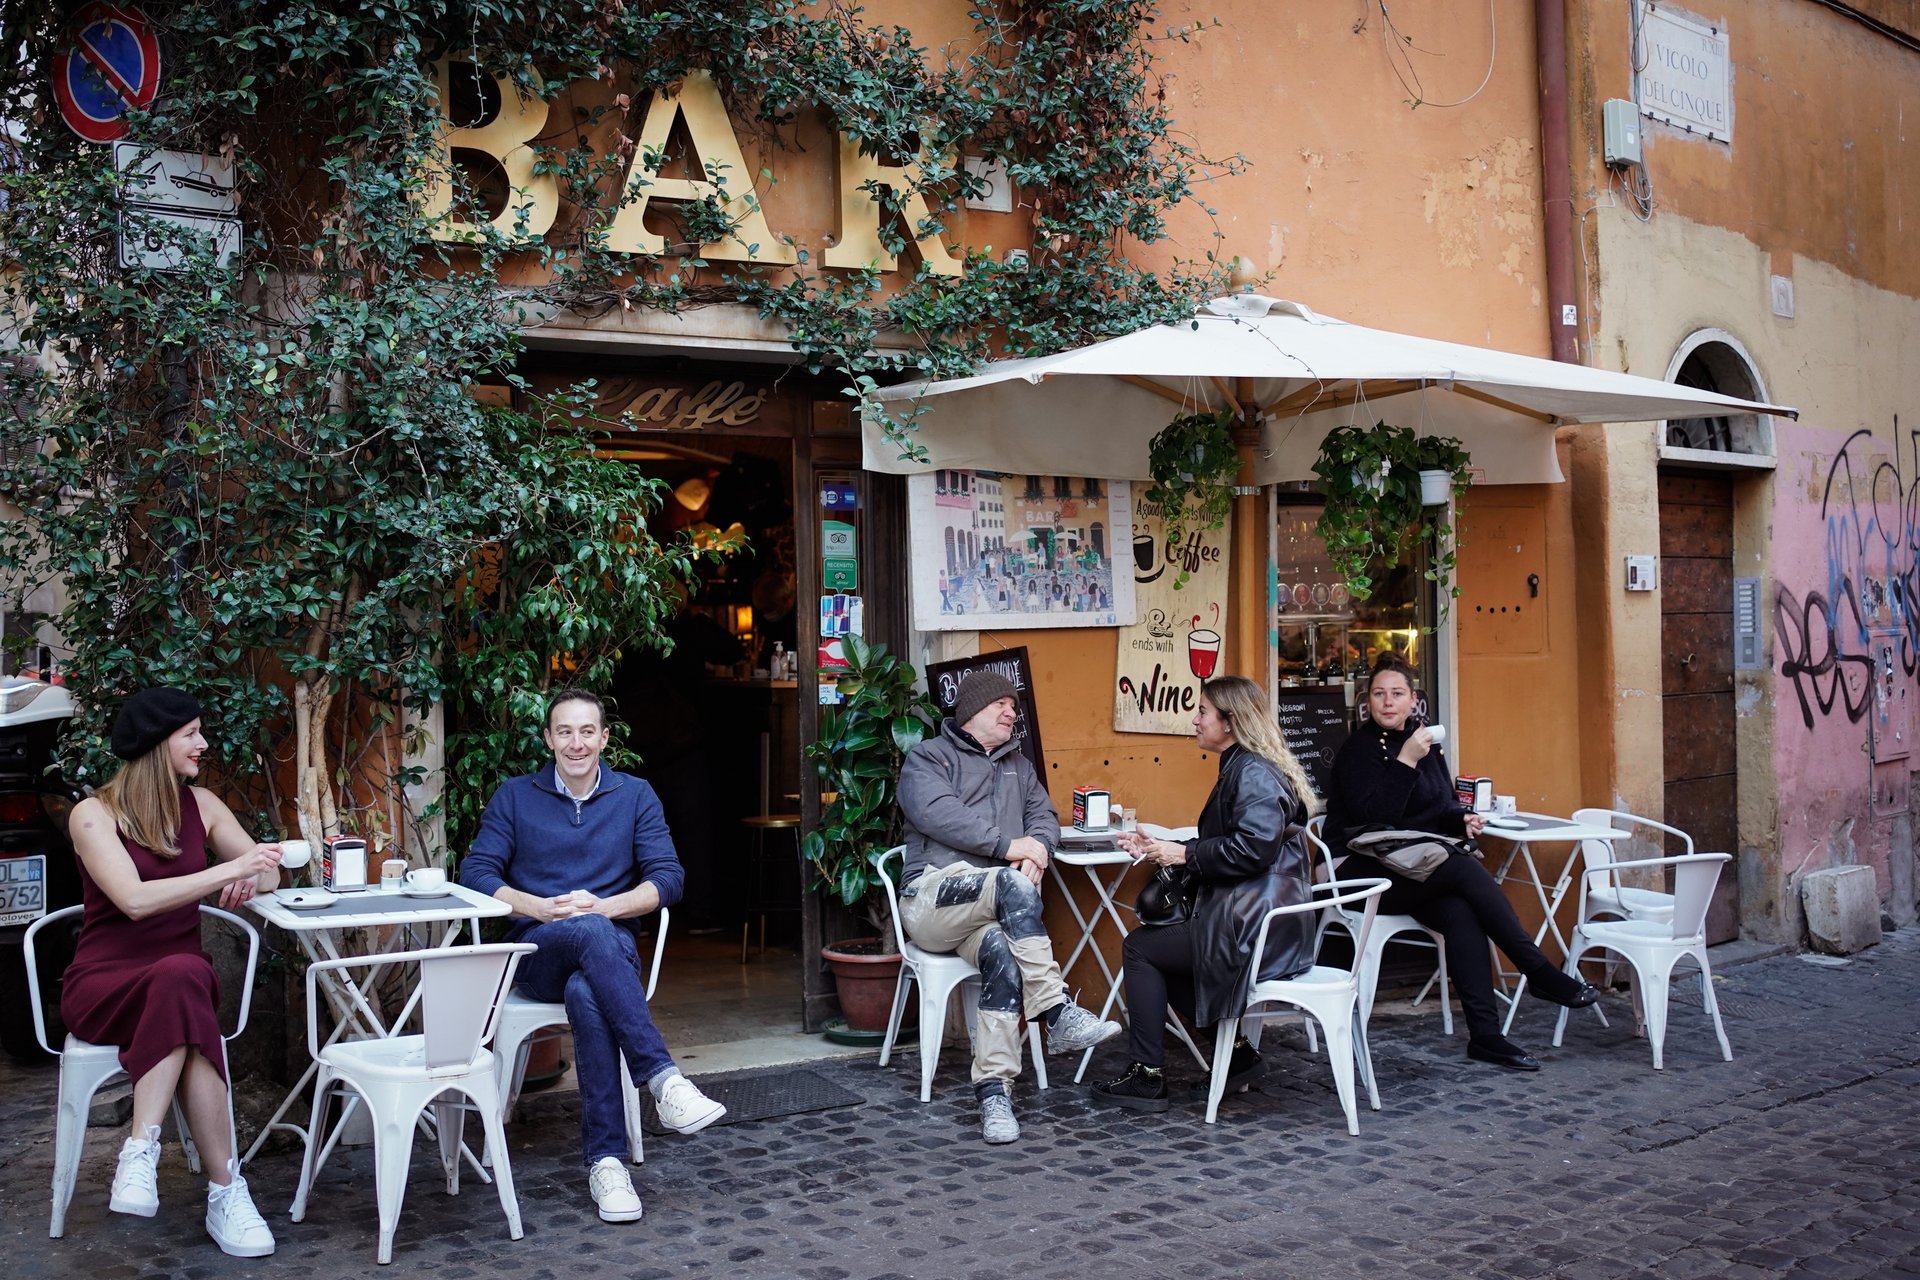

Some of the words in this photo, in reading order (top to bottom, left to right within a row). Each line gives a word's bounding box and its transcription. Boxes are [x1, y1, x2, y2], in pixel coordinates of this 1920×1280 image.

[1657, 44, 1708, 80] VICOLO
[1644, 77, 1667, 104] DEL
[1671, 88, 1723, 122] CINQUE
[412, 52, 963, 277] BAR
[1025, 510, 1055, 522] BAR
[1165, 528, 1220, 574] Coffee
[1132, 638, 1153, 652] ends
[1154, 639, 1174, 653] with
[1119, 664, 1195, 716] Wine
